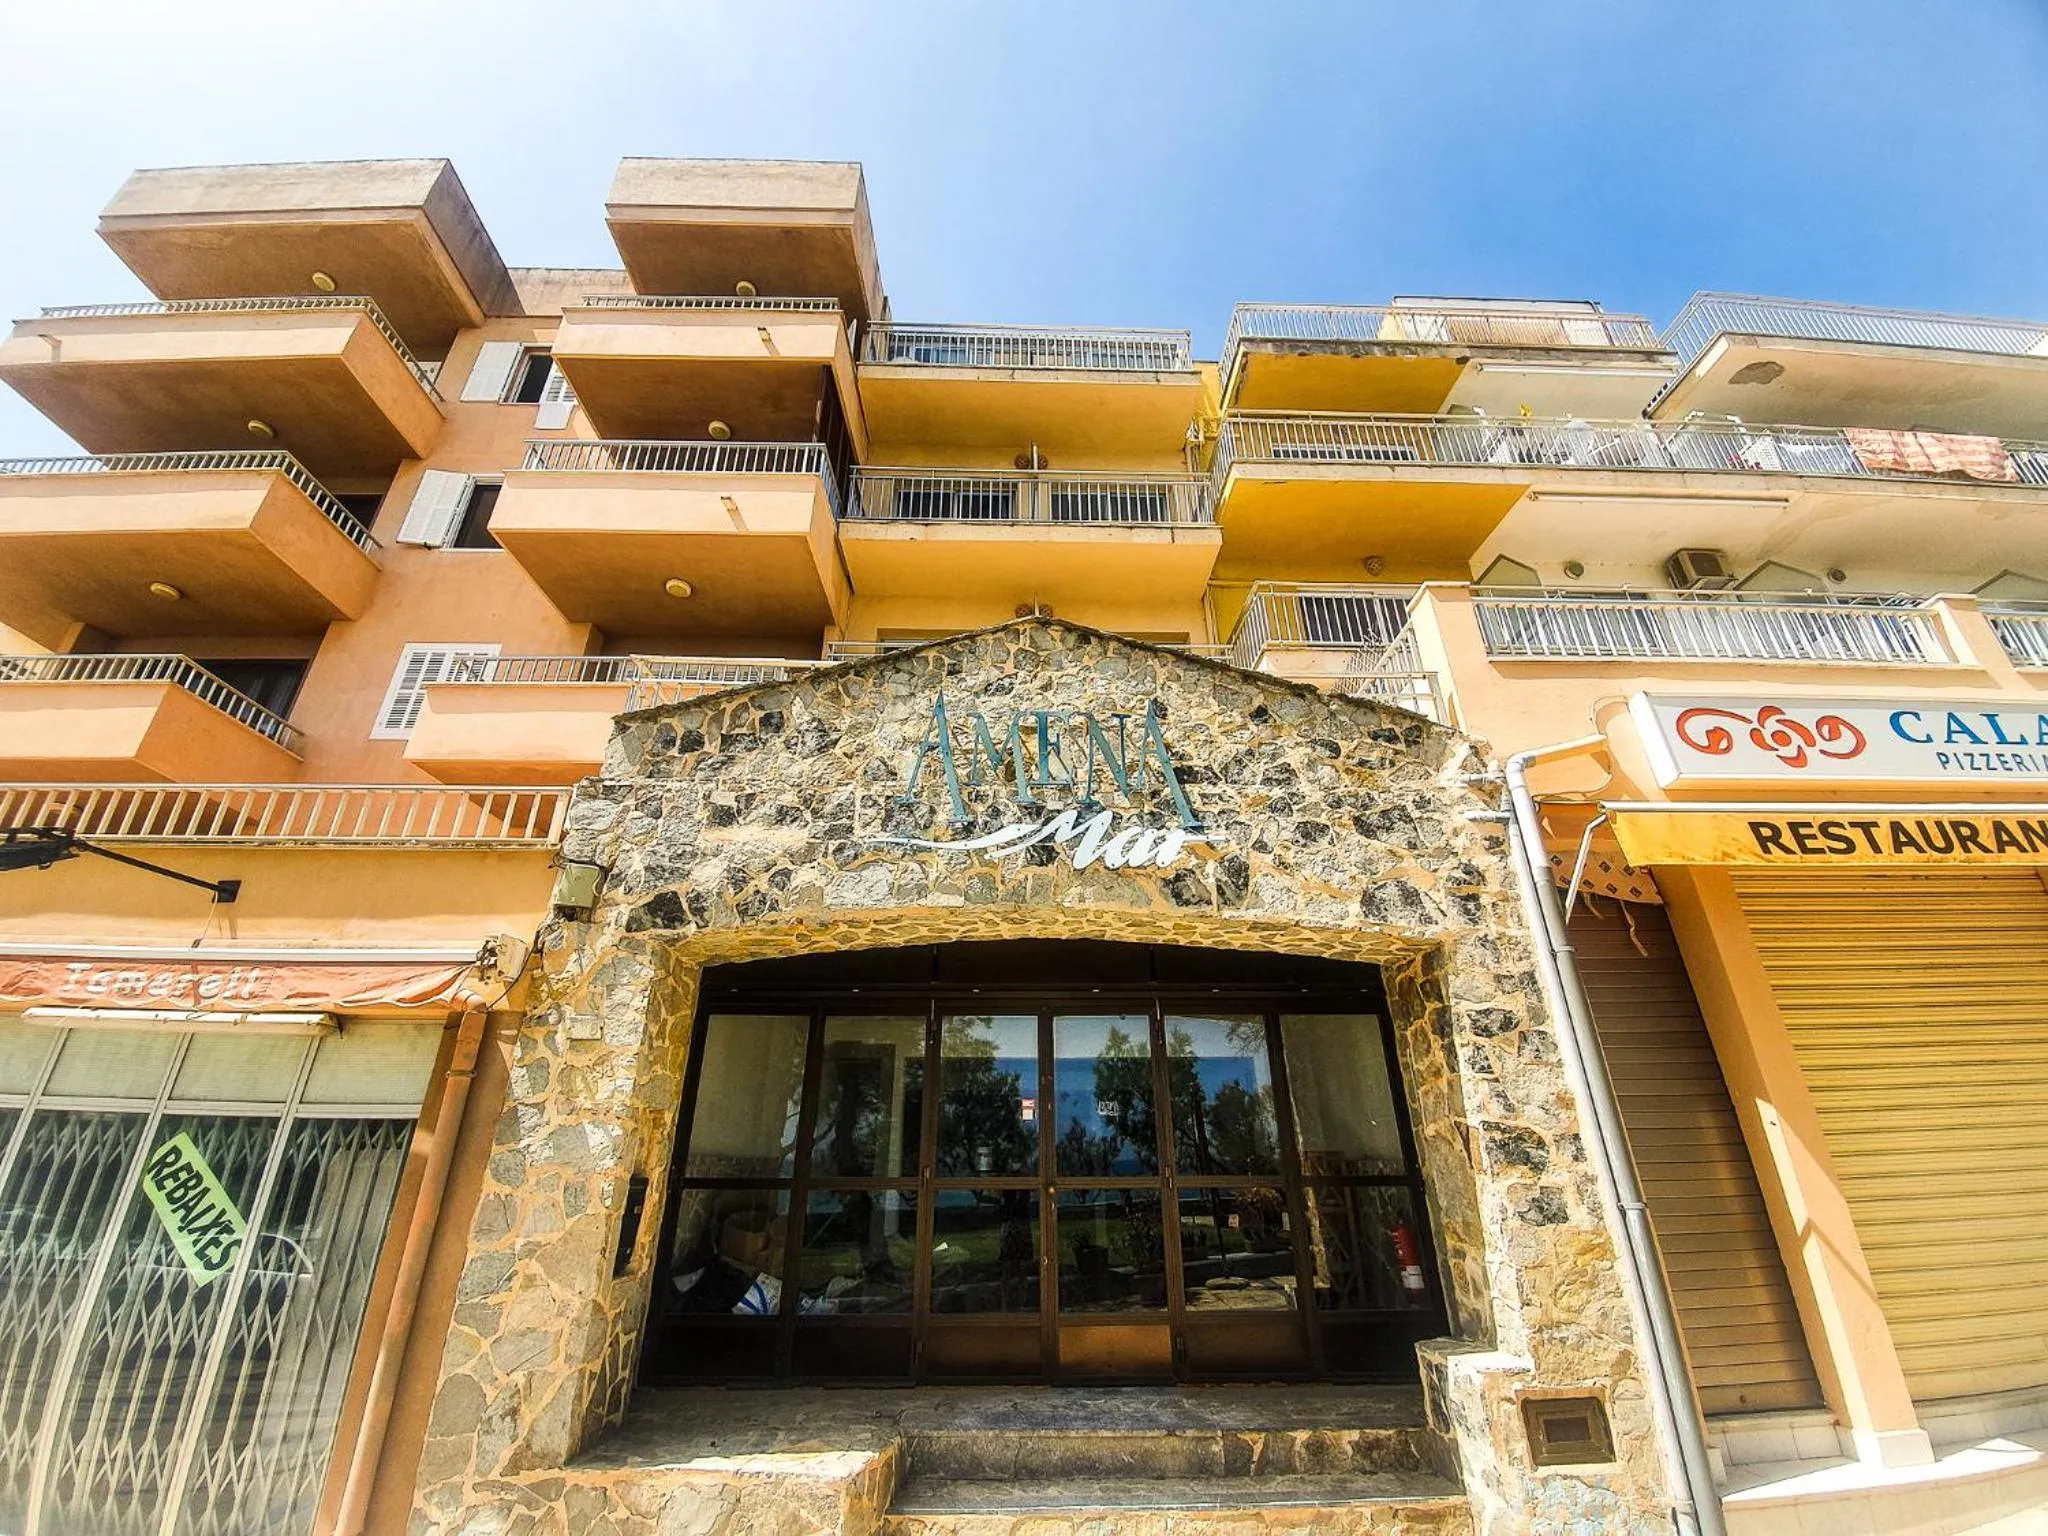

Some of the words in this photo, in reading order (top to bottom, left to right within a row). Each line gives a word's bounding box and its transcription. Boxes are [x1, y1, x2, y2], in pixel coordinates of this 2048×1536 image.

[1889, 711, 2048, 744] CAL
[894, 689, 1208, 823] AMENA
[1935, 752, 2048, 771] PIZZERI
[985, 809, 1227, 869] Mar
[1748, 821, 2048, 855] RESTAURAN
[148, 1144, 241, 1271] REBAIXES
